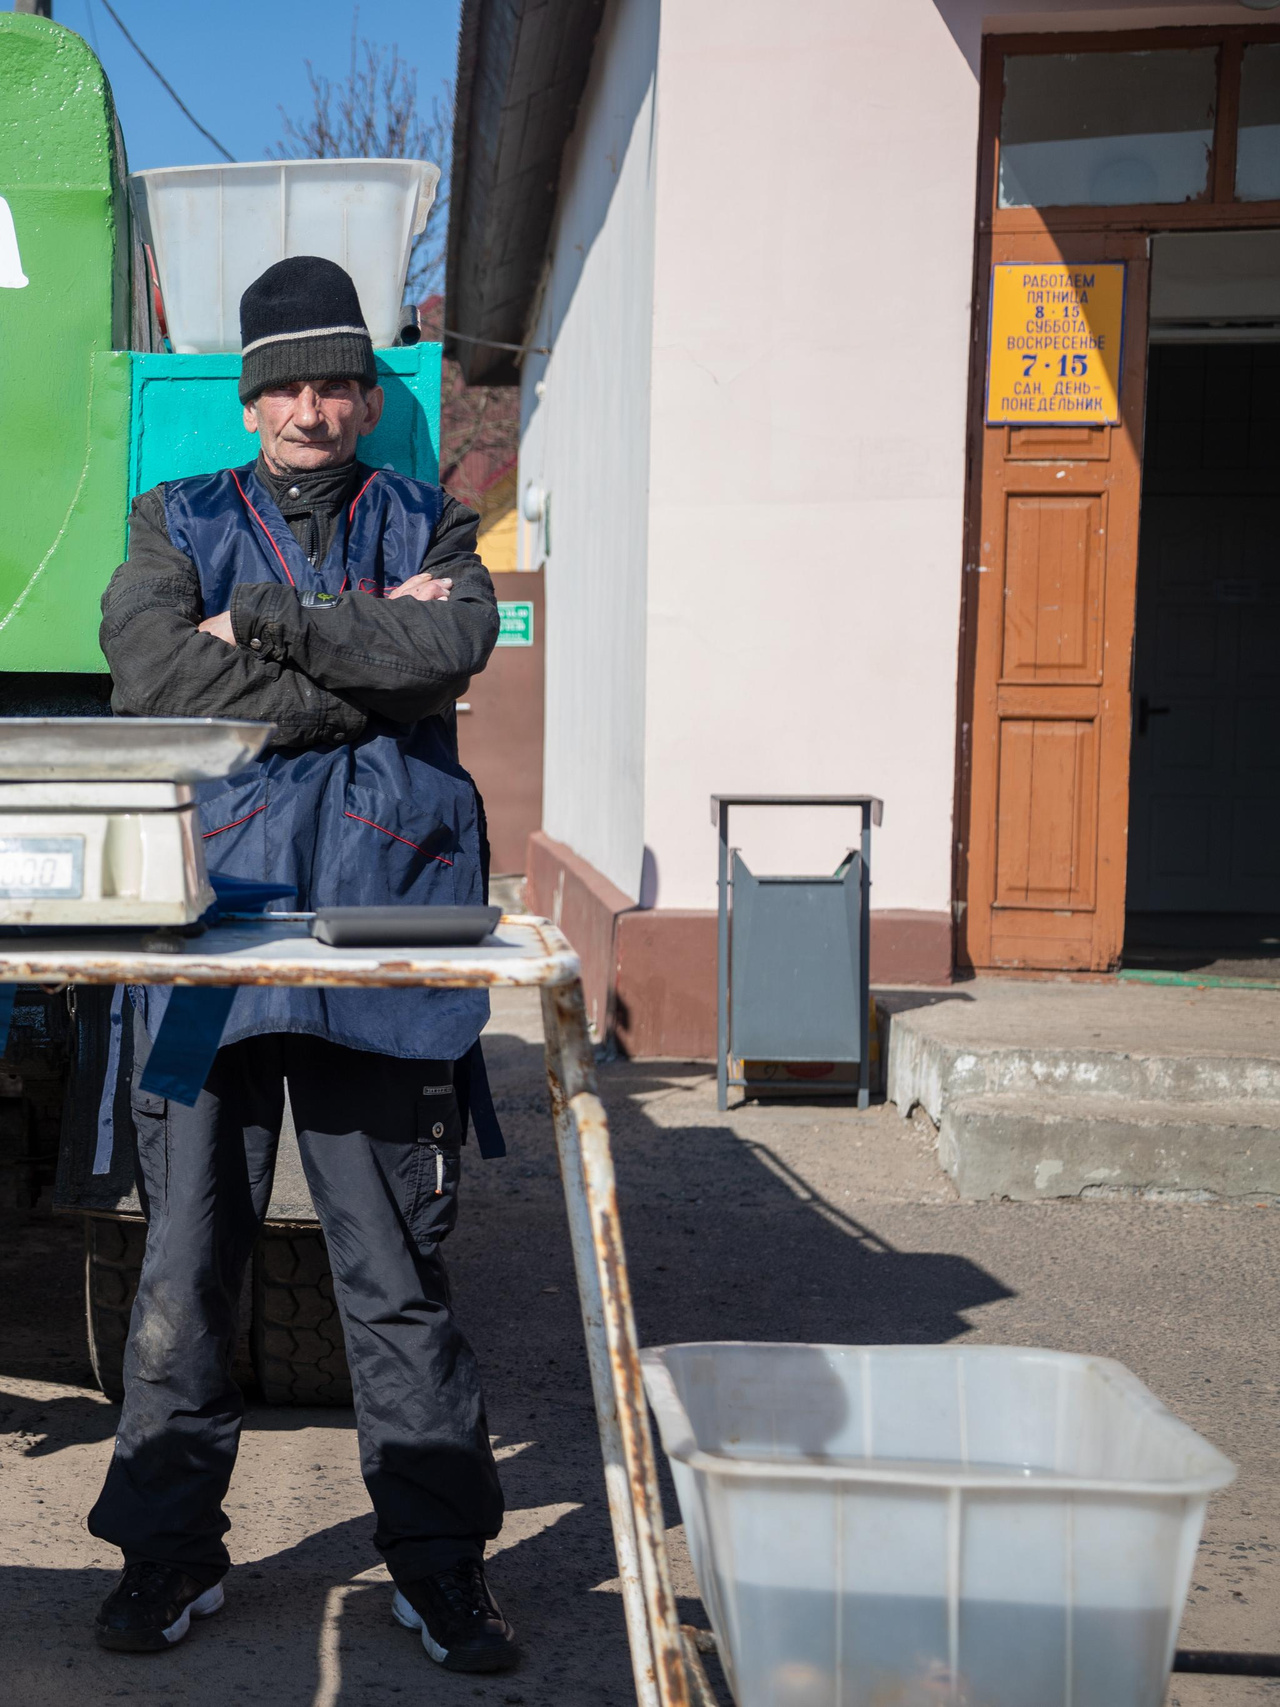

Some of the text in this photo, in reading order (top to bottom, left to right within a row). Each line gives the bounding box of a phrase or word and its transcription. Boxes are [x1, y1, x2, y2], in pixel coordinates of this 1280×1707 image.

[1022, 273, 1095, 289] РАБОТАЕМ
[1026, 290, 1089, 304] ПЯТНИЦА
[1007, 335, 1106, 350] ВОСКРЕСЕНЬЕ
[1013, 381, 1045, 396] САН.
[1001, 397, 1103, 412] ПОНЕДЕЛЬНИК
